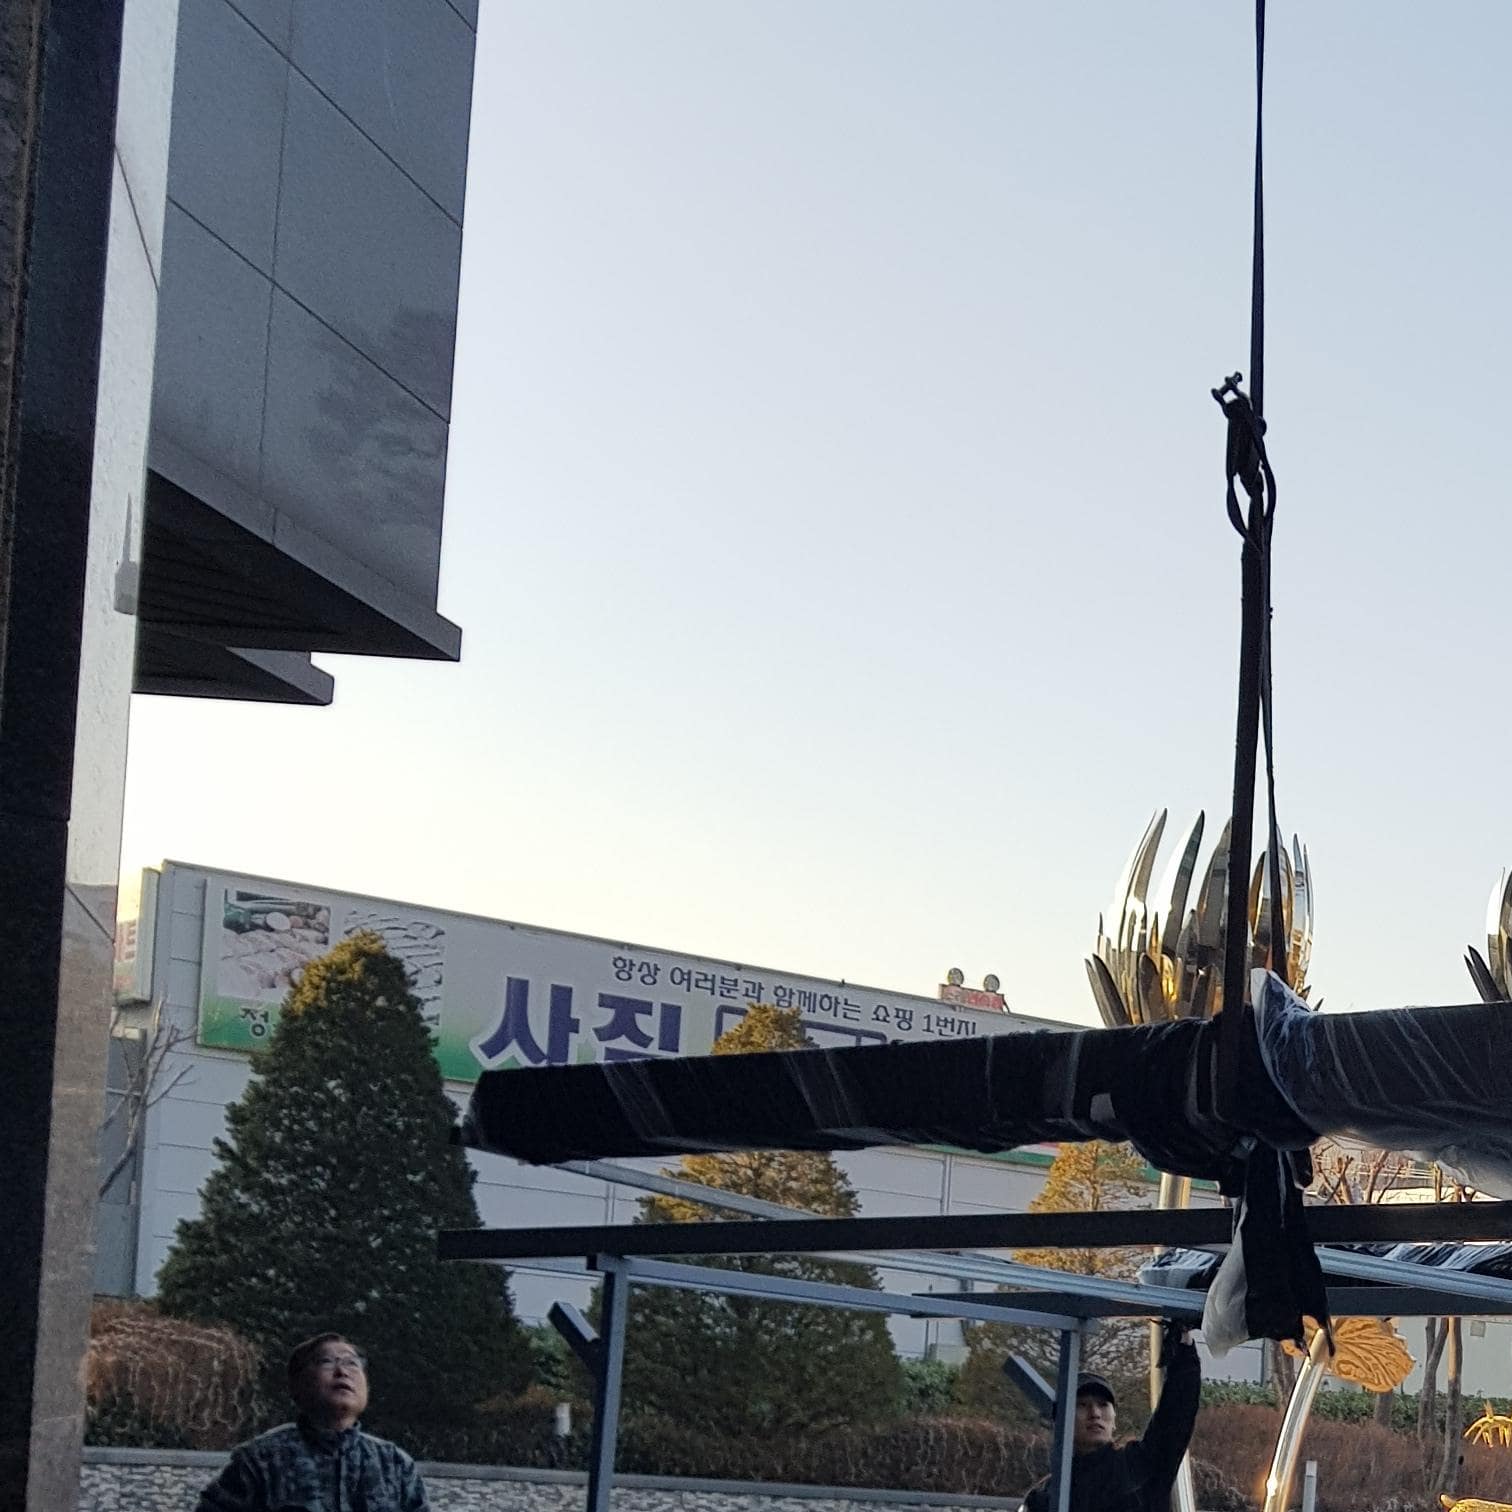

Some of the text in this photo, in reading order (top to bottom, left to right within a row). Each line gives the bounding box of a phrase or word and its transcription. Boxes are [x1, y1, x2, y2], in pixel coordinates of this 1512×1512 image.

[611, 955, 978, 1037] 항상 여러분과 함께하는 쇼핑 1번지
